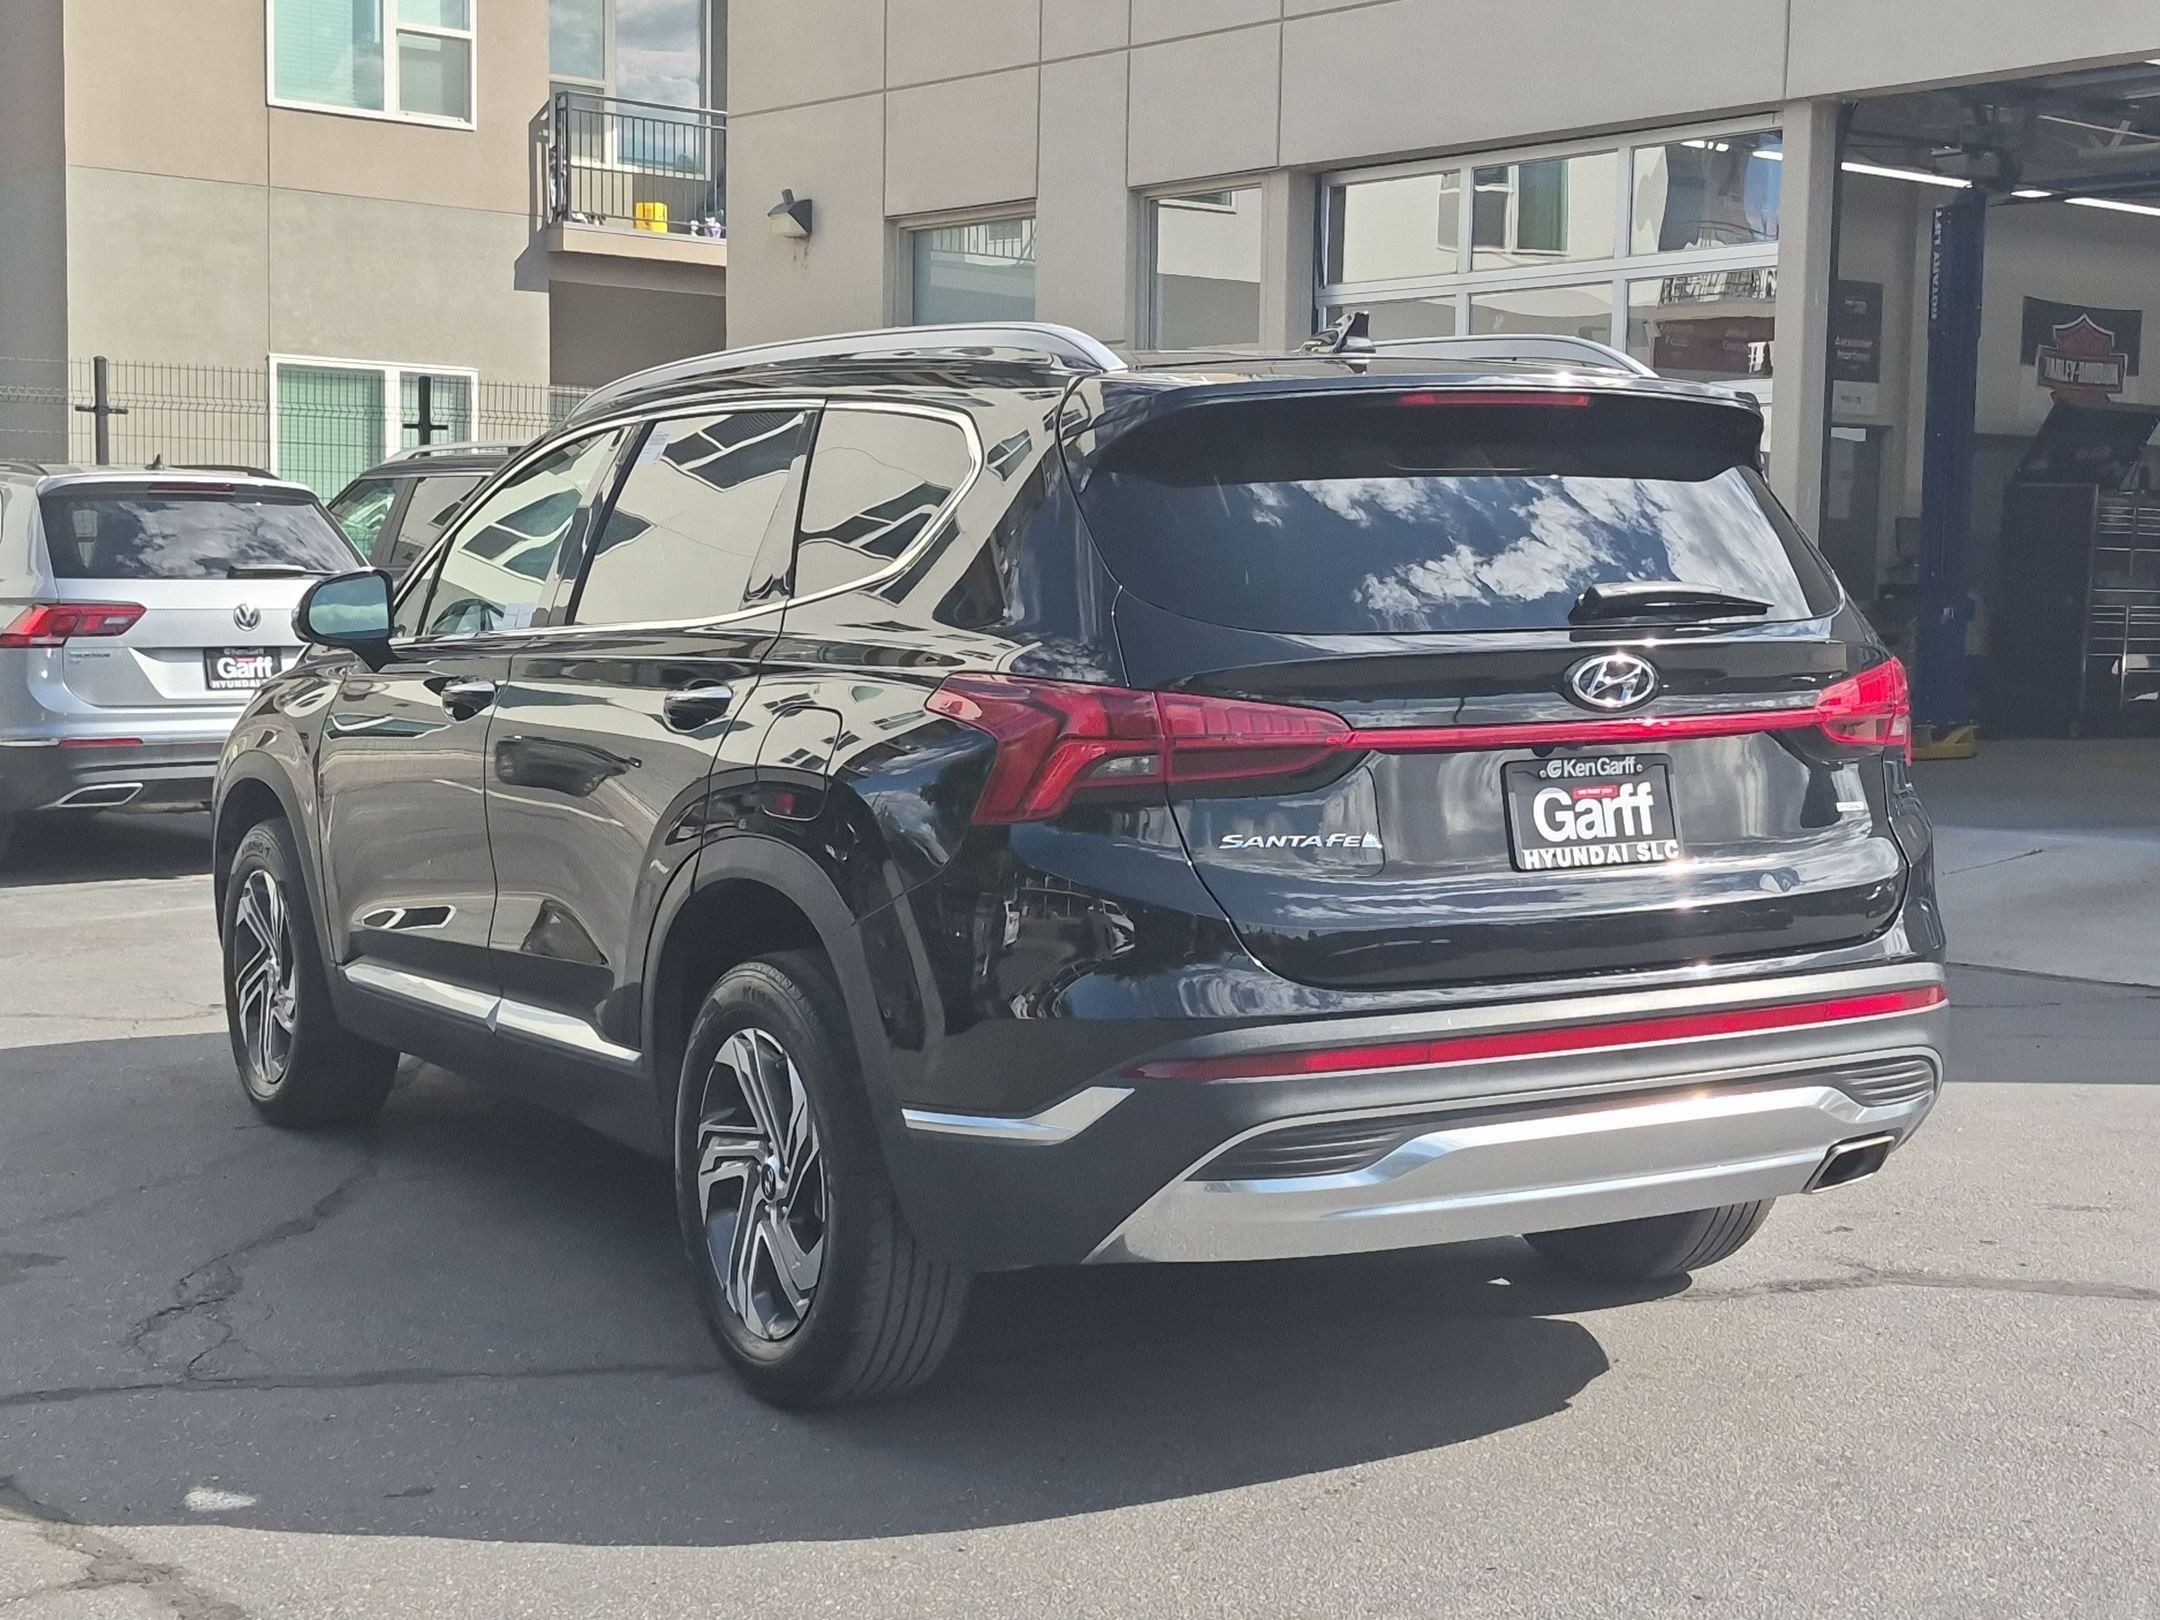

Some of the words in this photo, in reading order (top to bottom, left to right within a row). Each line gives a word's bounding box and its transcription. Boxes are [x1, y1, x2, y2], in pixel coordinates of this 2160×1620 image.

[217, 656, 273, 679] Garff
[1563, 758, 1596, 777] Ken
[1597, 756, 1636, 776] Garff
[1533, 782, 1654, 842] Garff
[1522, 845, 1629, 870] HYUNDAI
[1636, 840, 1679, 862] SLC
